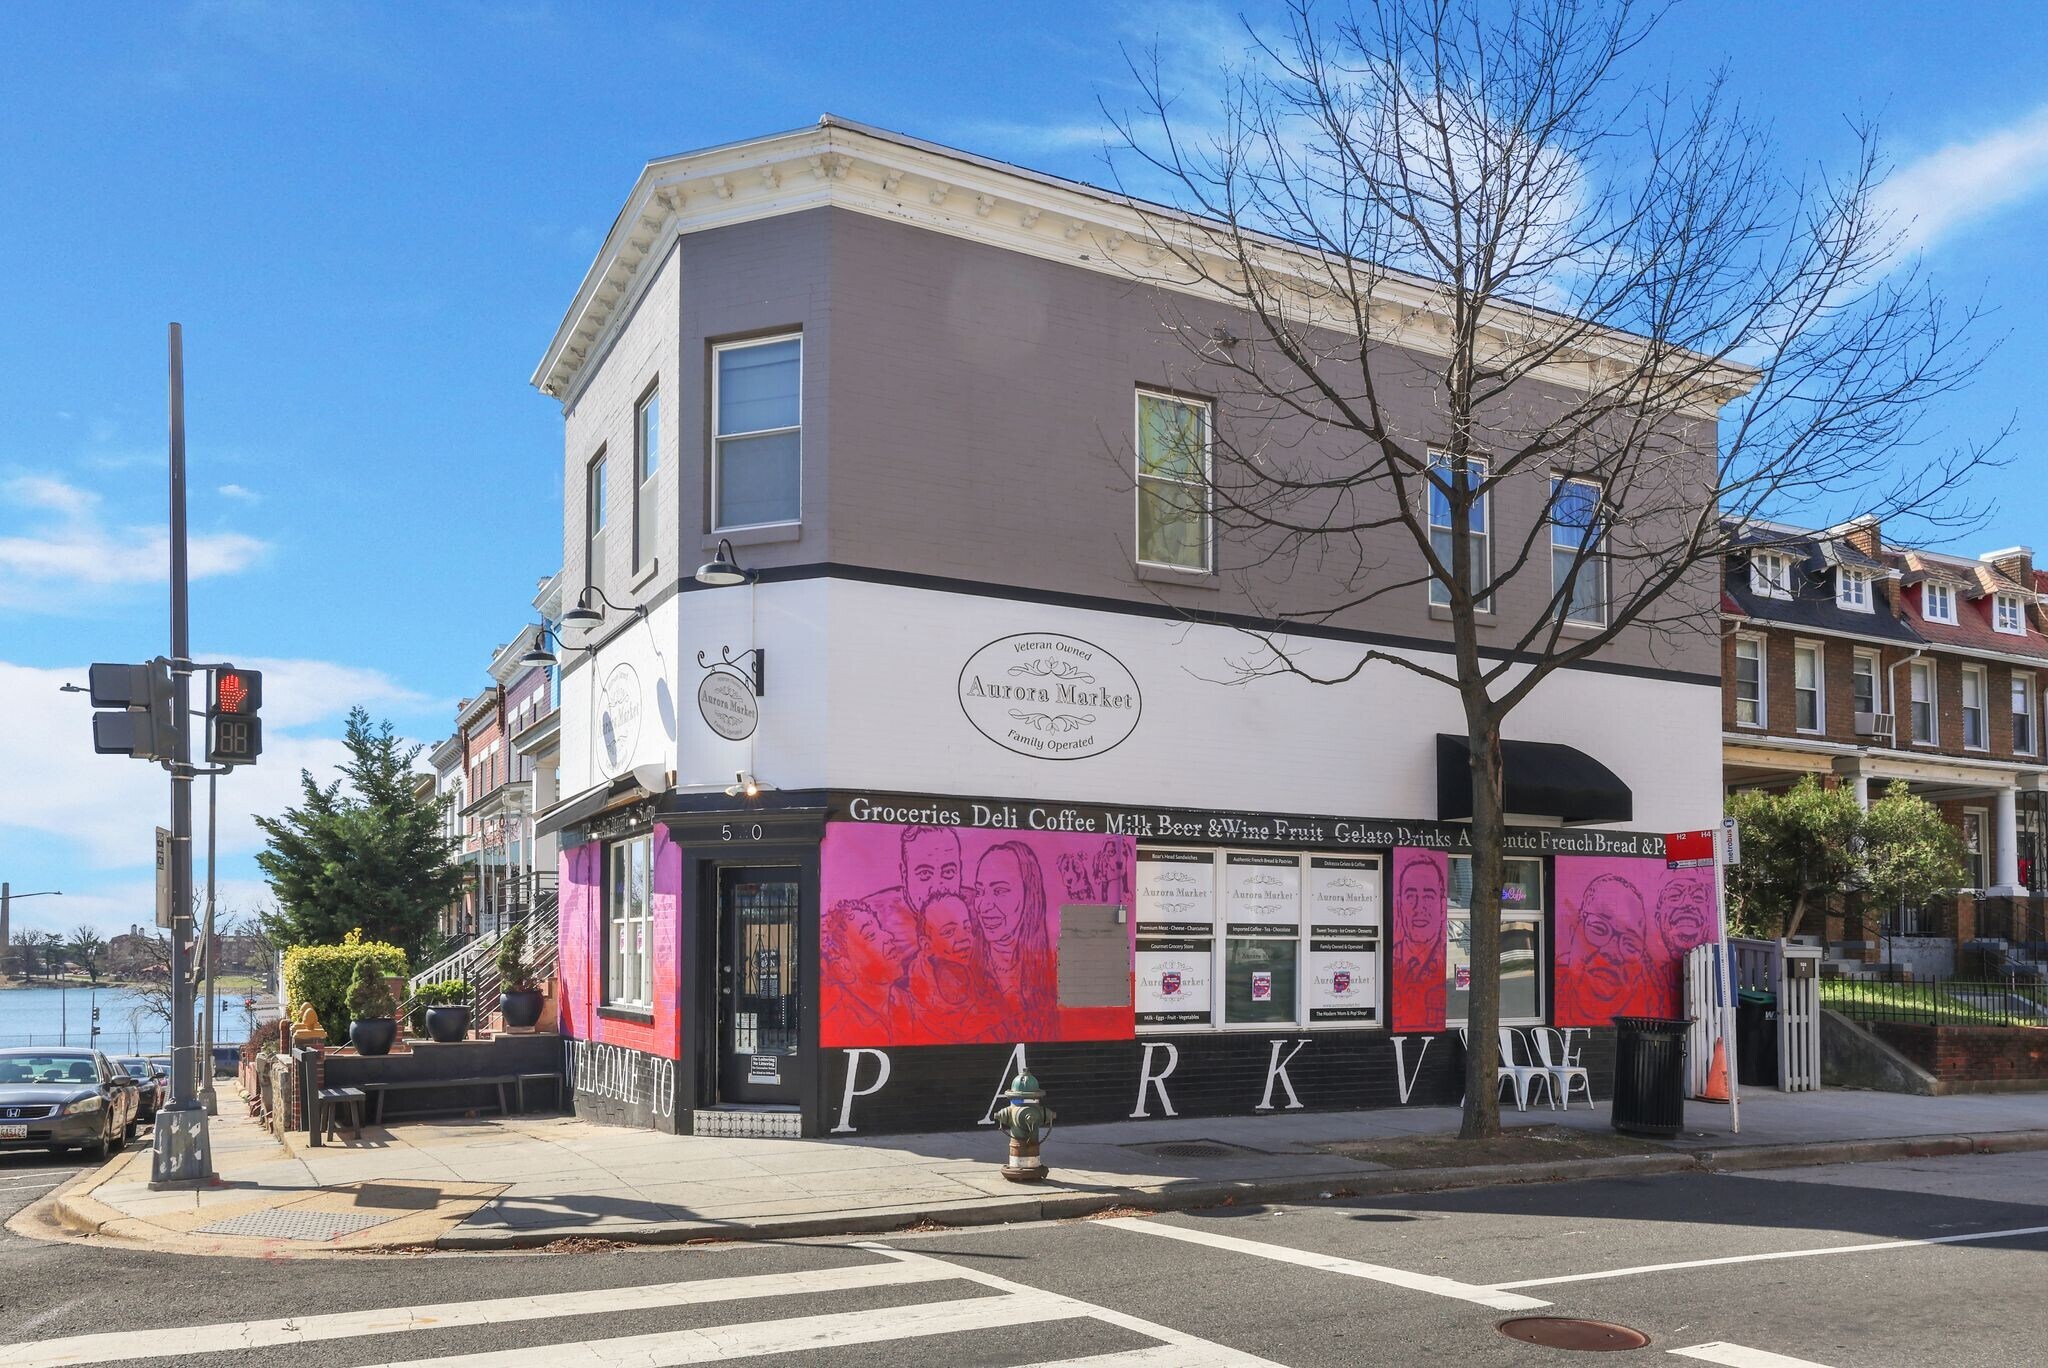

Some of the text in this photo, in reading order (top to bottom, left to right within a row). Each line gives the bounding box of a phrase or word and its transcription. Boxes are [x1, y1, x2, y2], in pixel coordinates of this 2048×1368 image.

[1014, 641, 1093, 661] Veteran Owned
[966, 675, 1133, 710] Aurora Market
[1007, 729, 1094, 752] Family Operated
[849, 797, 961, 825] Groceries
[971, 804, 1018, 828] Deli
[1028, 808, 1096, 832] Coffee
[1105, 812, 1153, 837] Milk
[1157, 814, 1202, 837] Beer
[1273, 819, 1324, 842] Fruit
[1334, 823, 1394, 844] Gelato
[1397, 827, 1452, 847] Drinks
[1458, 827, 1537, 849] Aentic
[1676, 833, 1687, 841] H2
[1726, 829, 1734, 863] metrobus
[1142, 887, 1207, 897] Aurora Market
[1232, 889, 1293, 900] Aurora Market
[1316, 892, 1373, 902] Aurora Market
[1141, 977, 1163, 986] Auro
[1181, 977, 1204, 986] arket
[1314, 976, 1334, 984] Auro
[1350, 976, 1370, 984] arket
[564, 1038, 675, 1118] WELCOME TO
